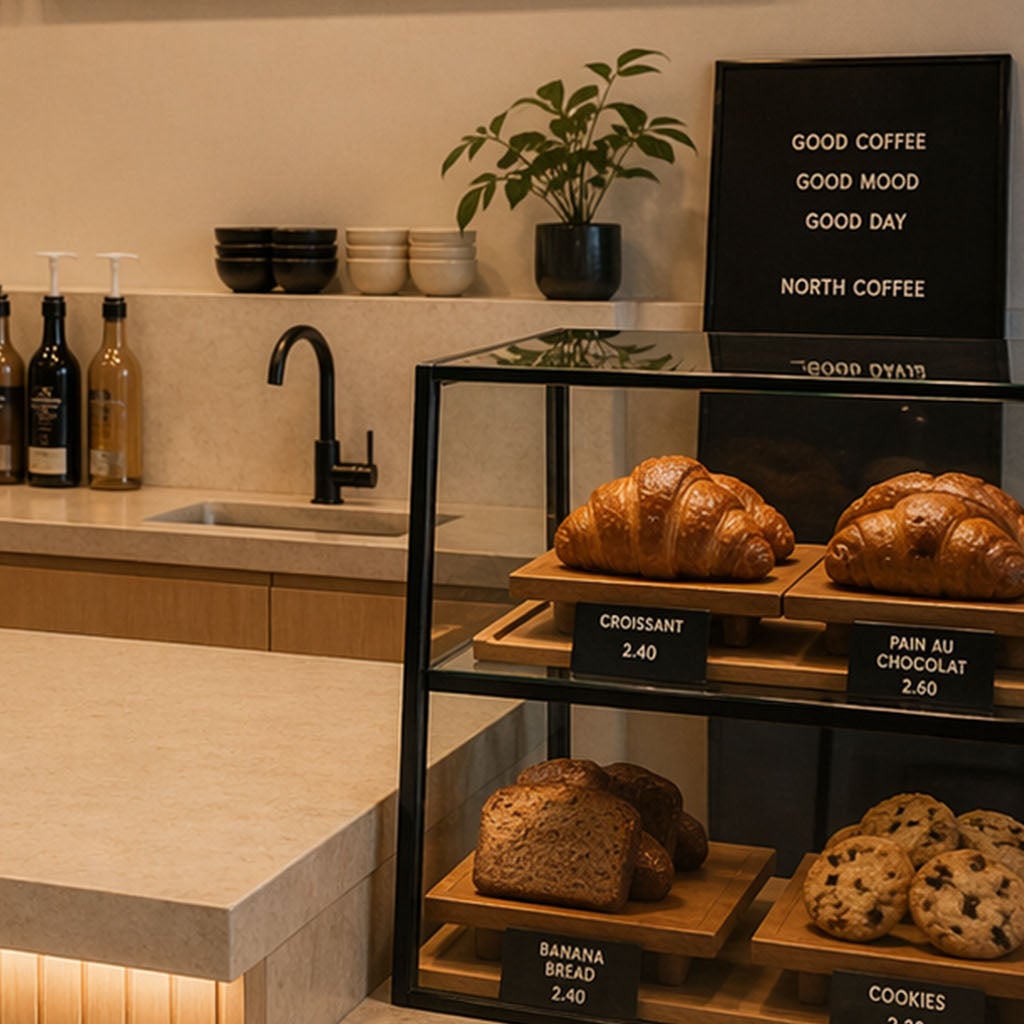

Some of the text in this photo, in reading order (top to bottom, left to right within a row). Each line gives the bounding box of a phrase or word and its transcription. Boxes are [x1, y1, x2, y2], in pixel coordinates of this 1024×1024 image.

[791, 132, 926, 151] GOOD COFFEE
[796, 172, 920, 191] GOOD MOOD
[805, 212, 907, 230] GOOD DAY
[781, 277, 925, 298] NORTH COFFEE
[599, 613, 684, 633] CROISSANT
[622, 642, 657, 661] 2.40
[889, 635, 954, 654] PAIN AU
[876, 653, 968, 675] CHOCOLAT
[902, 678, 938, 697] 2.60
[539, 941, 604, 965] BANANA
[545, 960, 596, 982] BREAD
[551, 985, 586, 1005] 2.40
[868, 985, 946, 1011] COOKIES
